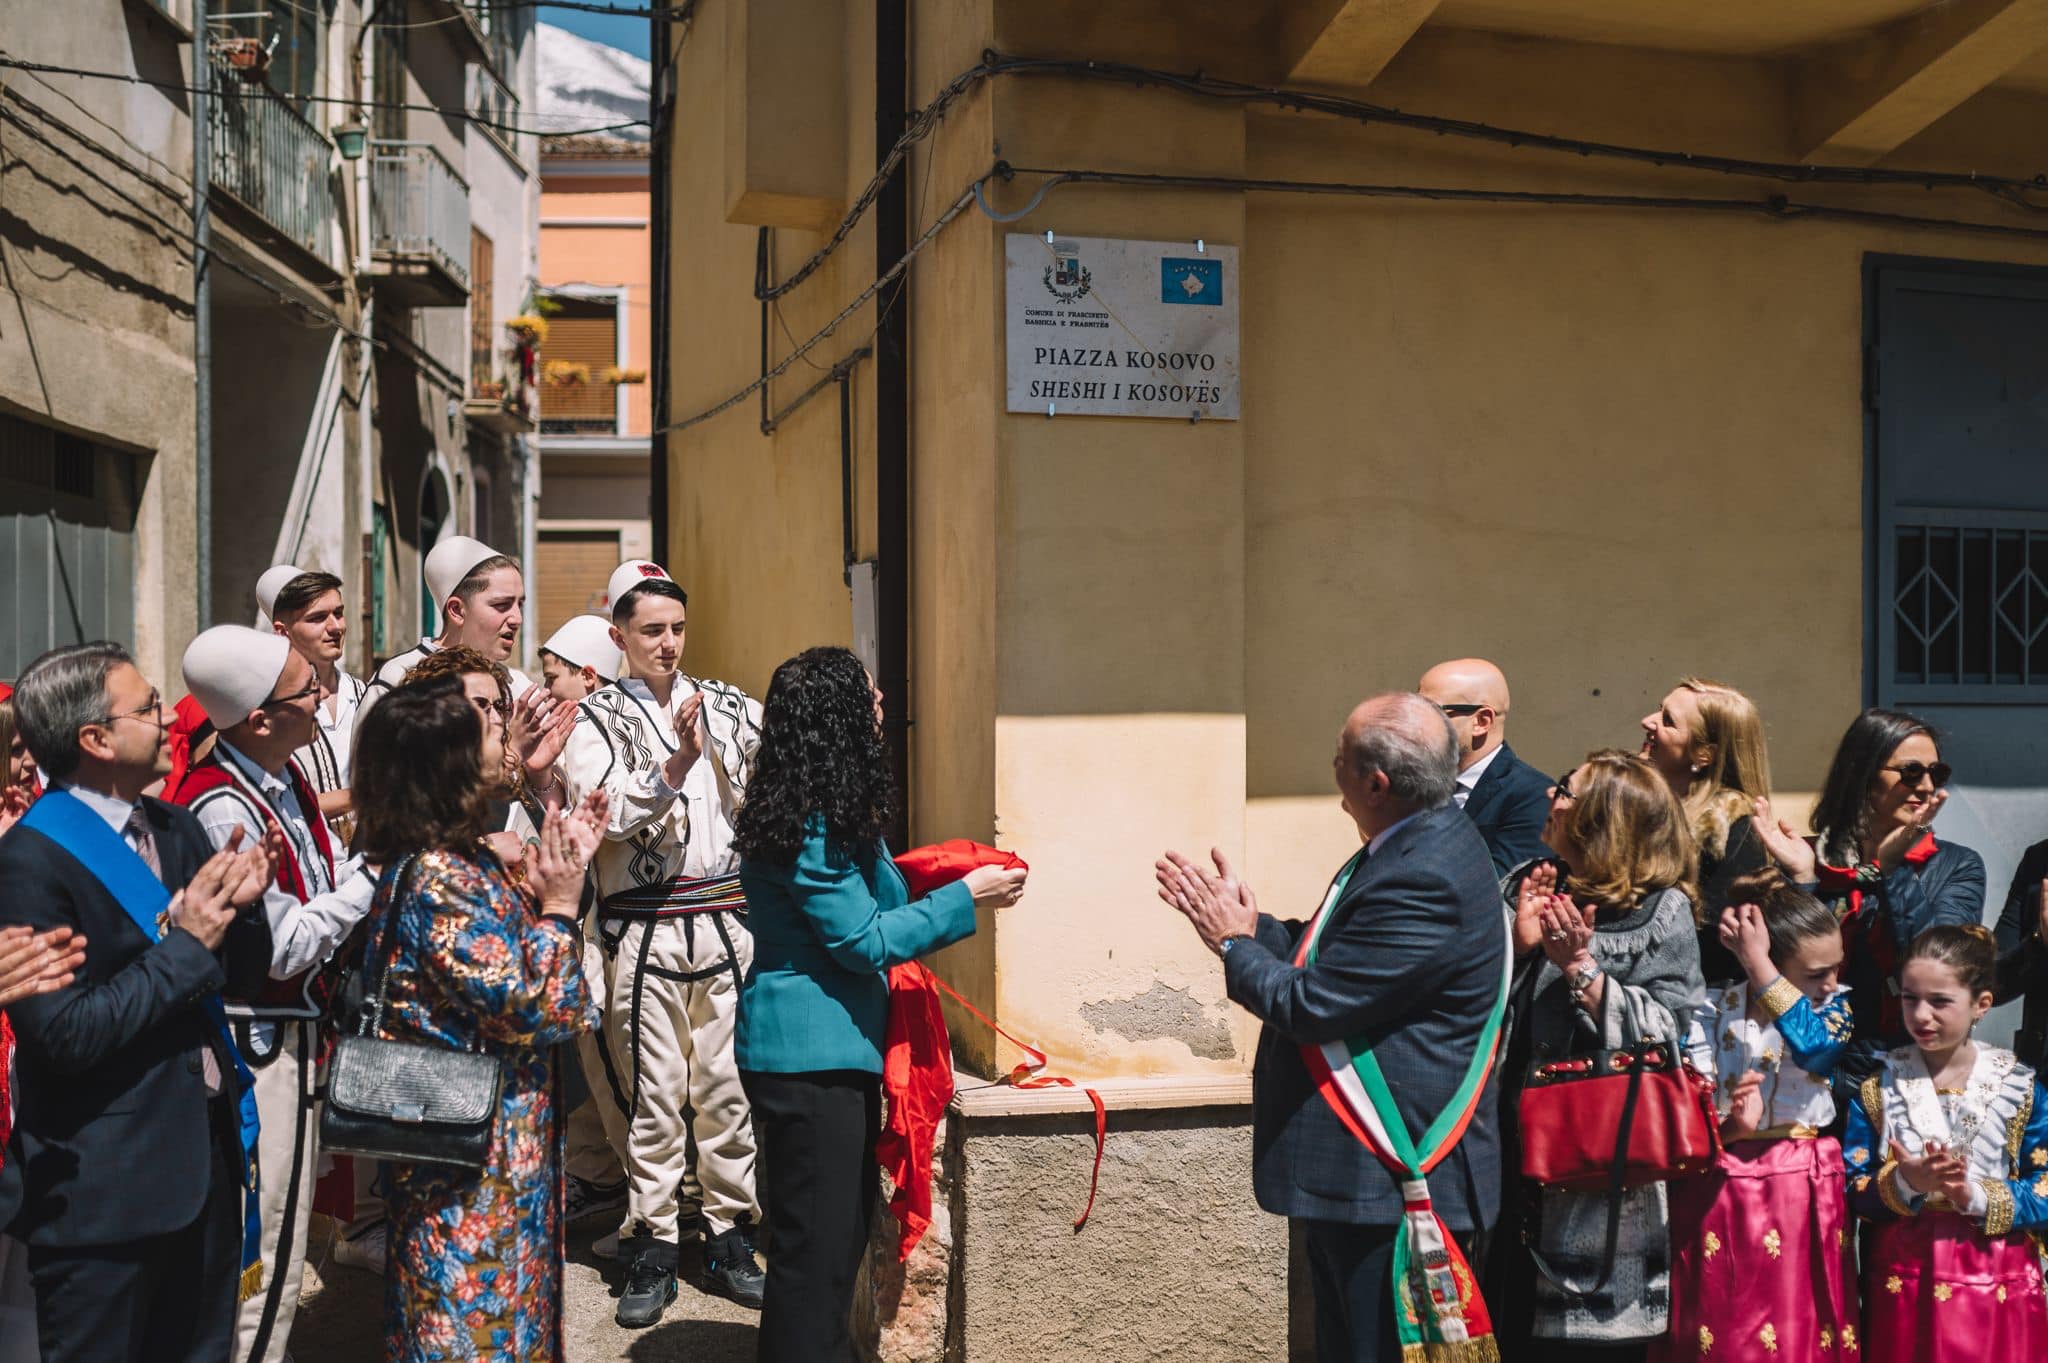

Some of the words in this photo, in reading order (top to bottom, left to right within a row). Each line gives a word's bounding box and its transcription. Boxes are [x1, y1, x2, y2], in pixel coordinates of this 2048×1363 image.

[1025, 309, 1053, 317] COMUNE
[1068, 311, 1109, 319] FRASCINETO
[1035, 347, 1118, 368] PIAZZA
[1126, 350, 1215, 371] KOSOVO
[1030, 380, 1107, 400] SHESHI
[1112, 383, 1121, 400] I
[1128, 380, 1220, 404] KOSOVËS
